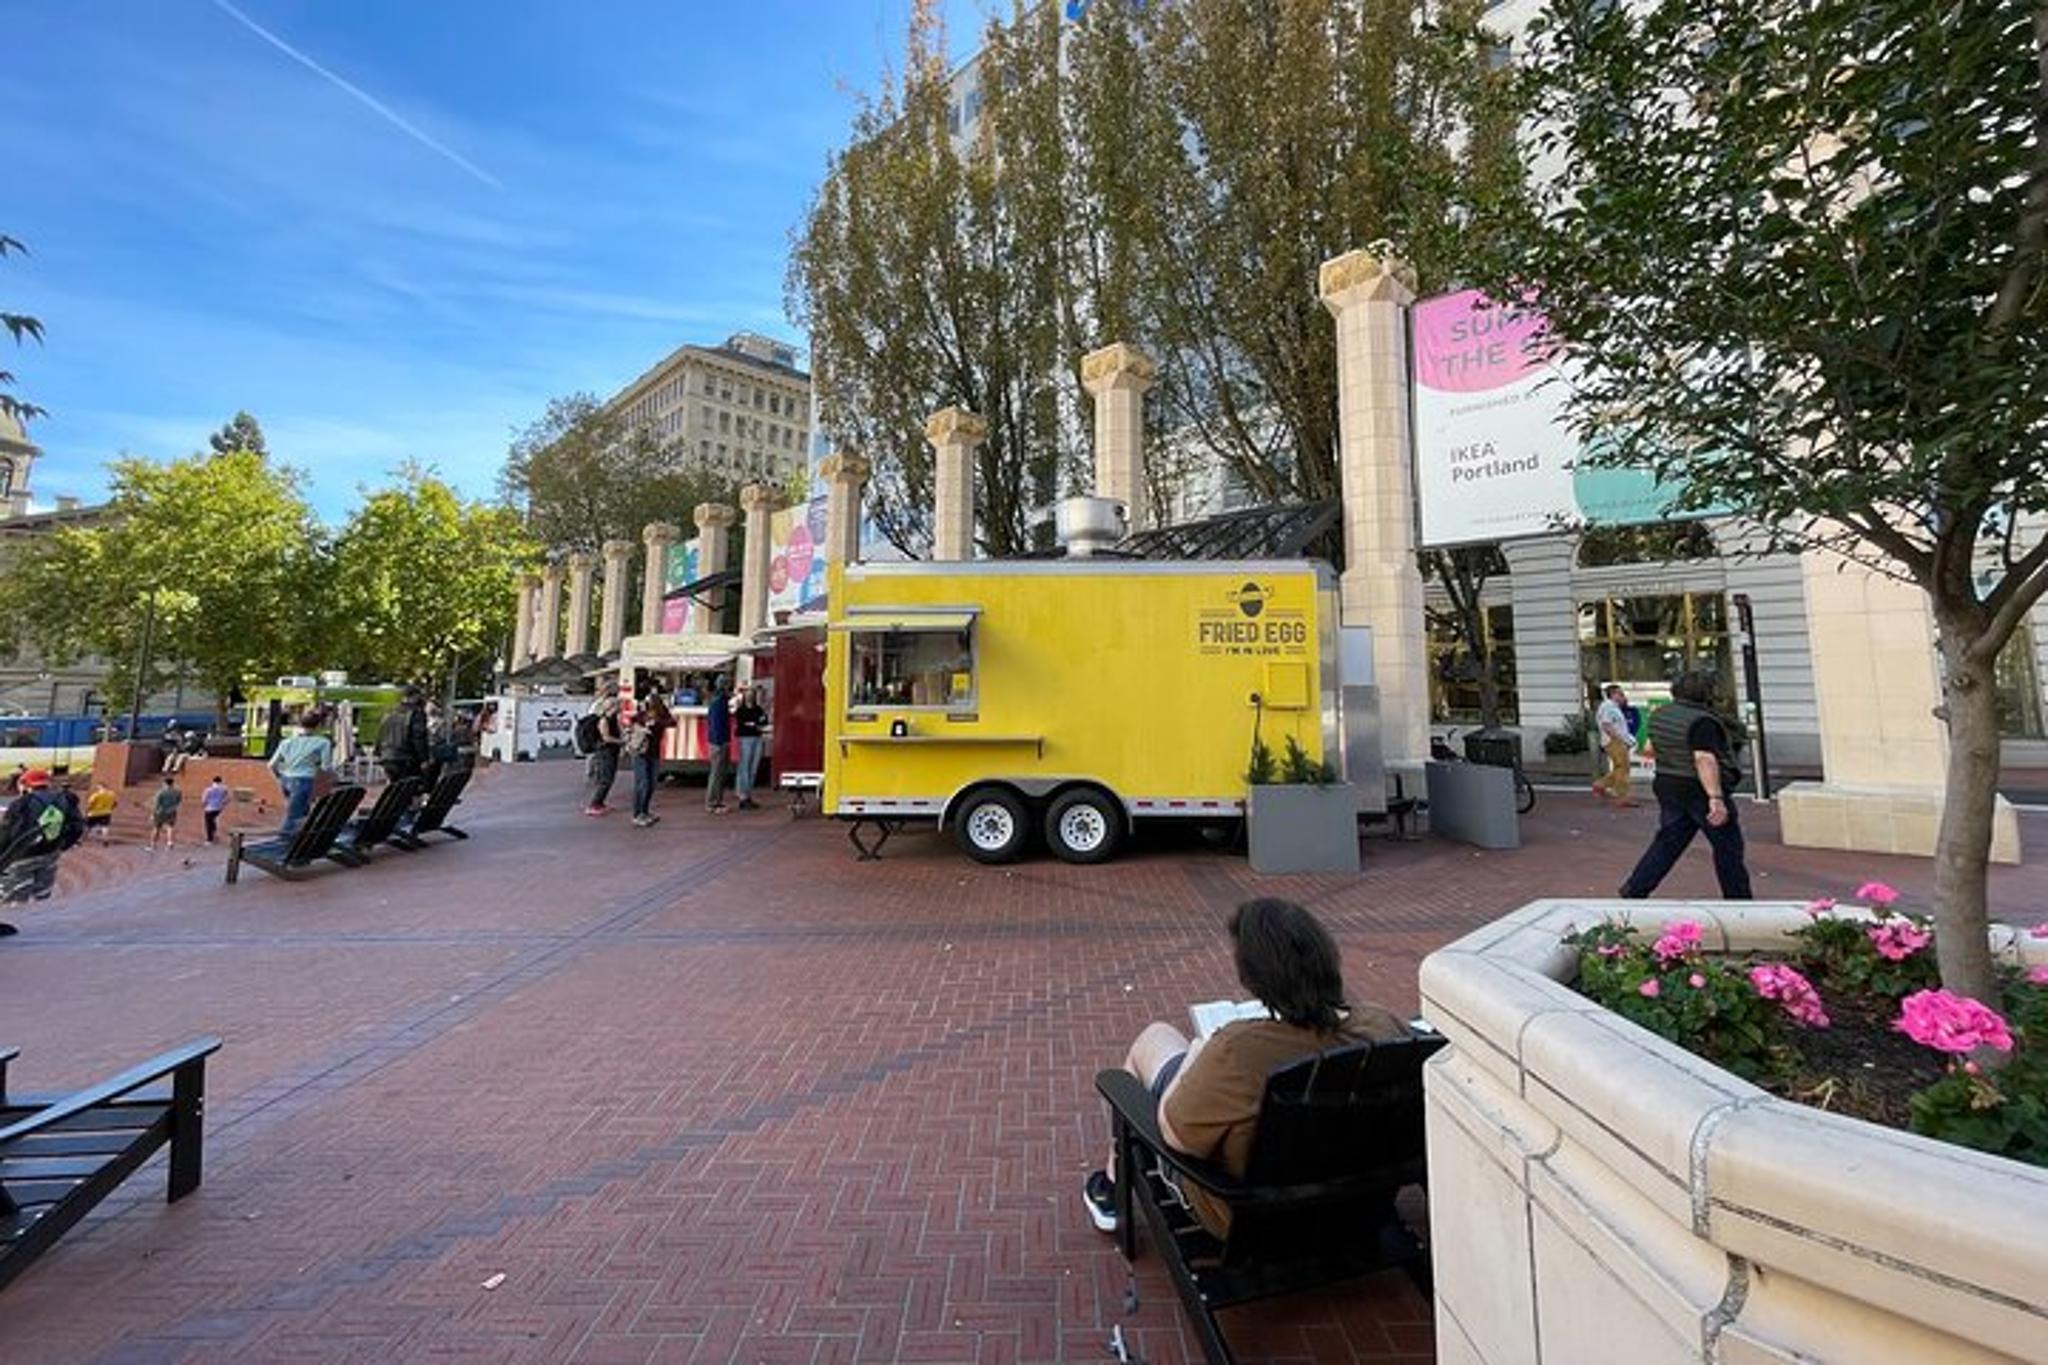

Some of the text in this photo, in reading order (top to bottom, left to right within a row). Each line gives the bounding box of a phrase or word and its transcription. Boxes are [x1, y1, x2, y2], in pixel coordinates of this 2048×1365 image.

[1442, 342, 1505, 376] THE
[1450, 442, 1497, 463] IKEA
[1453, 454, 1538, 482] Portland
[1199, 621, 1306, 644] FRIED EGG
